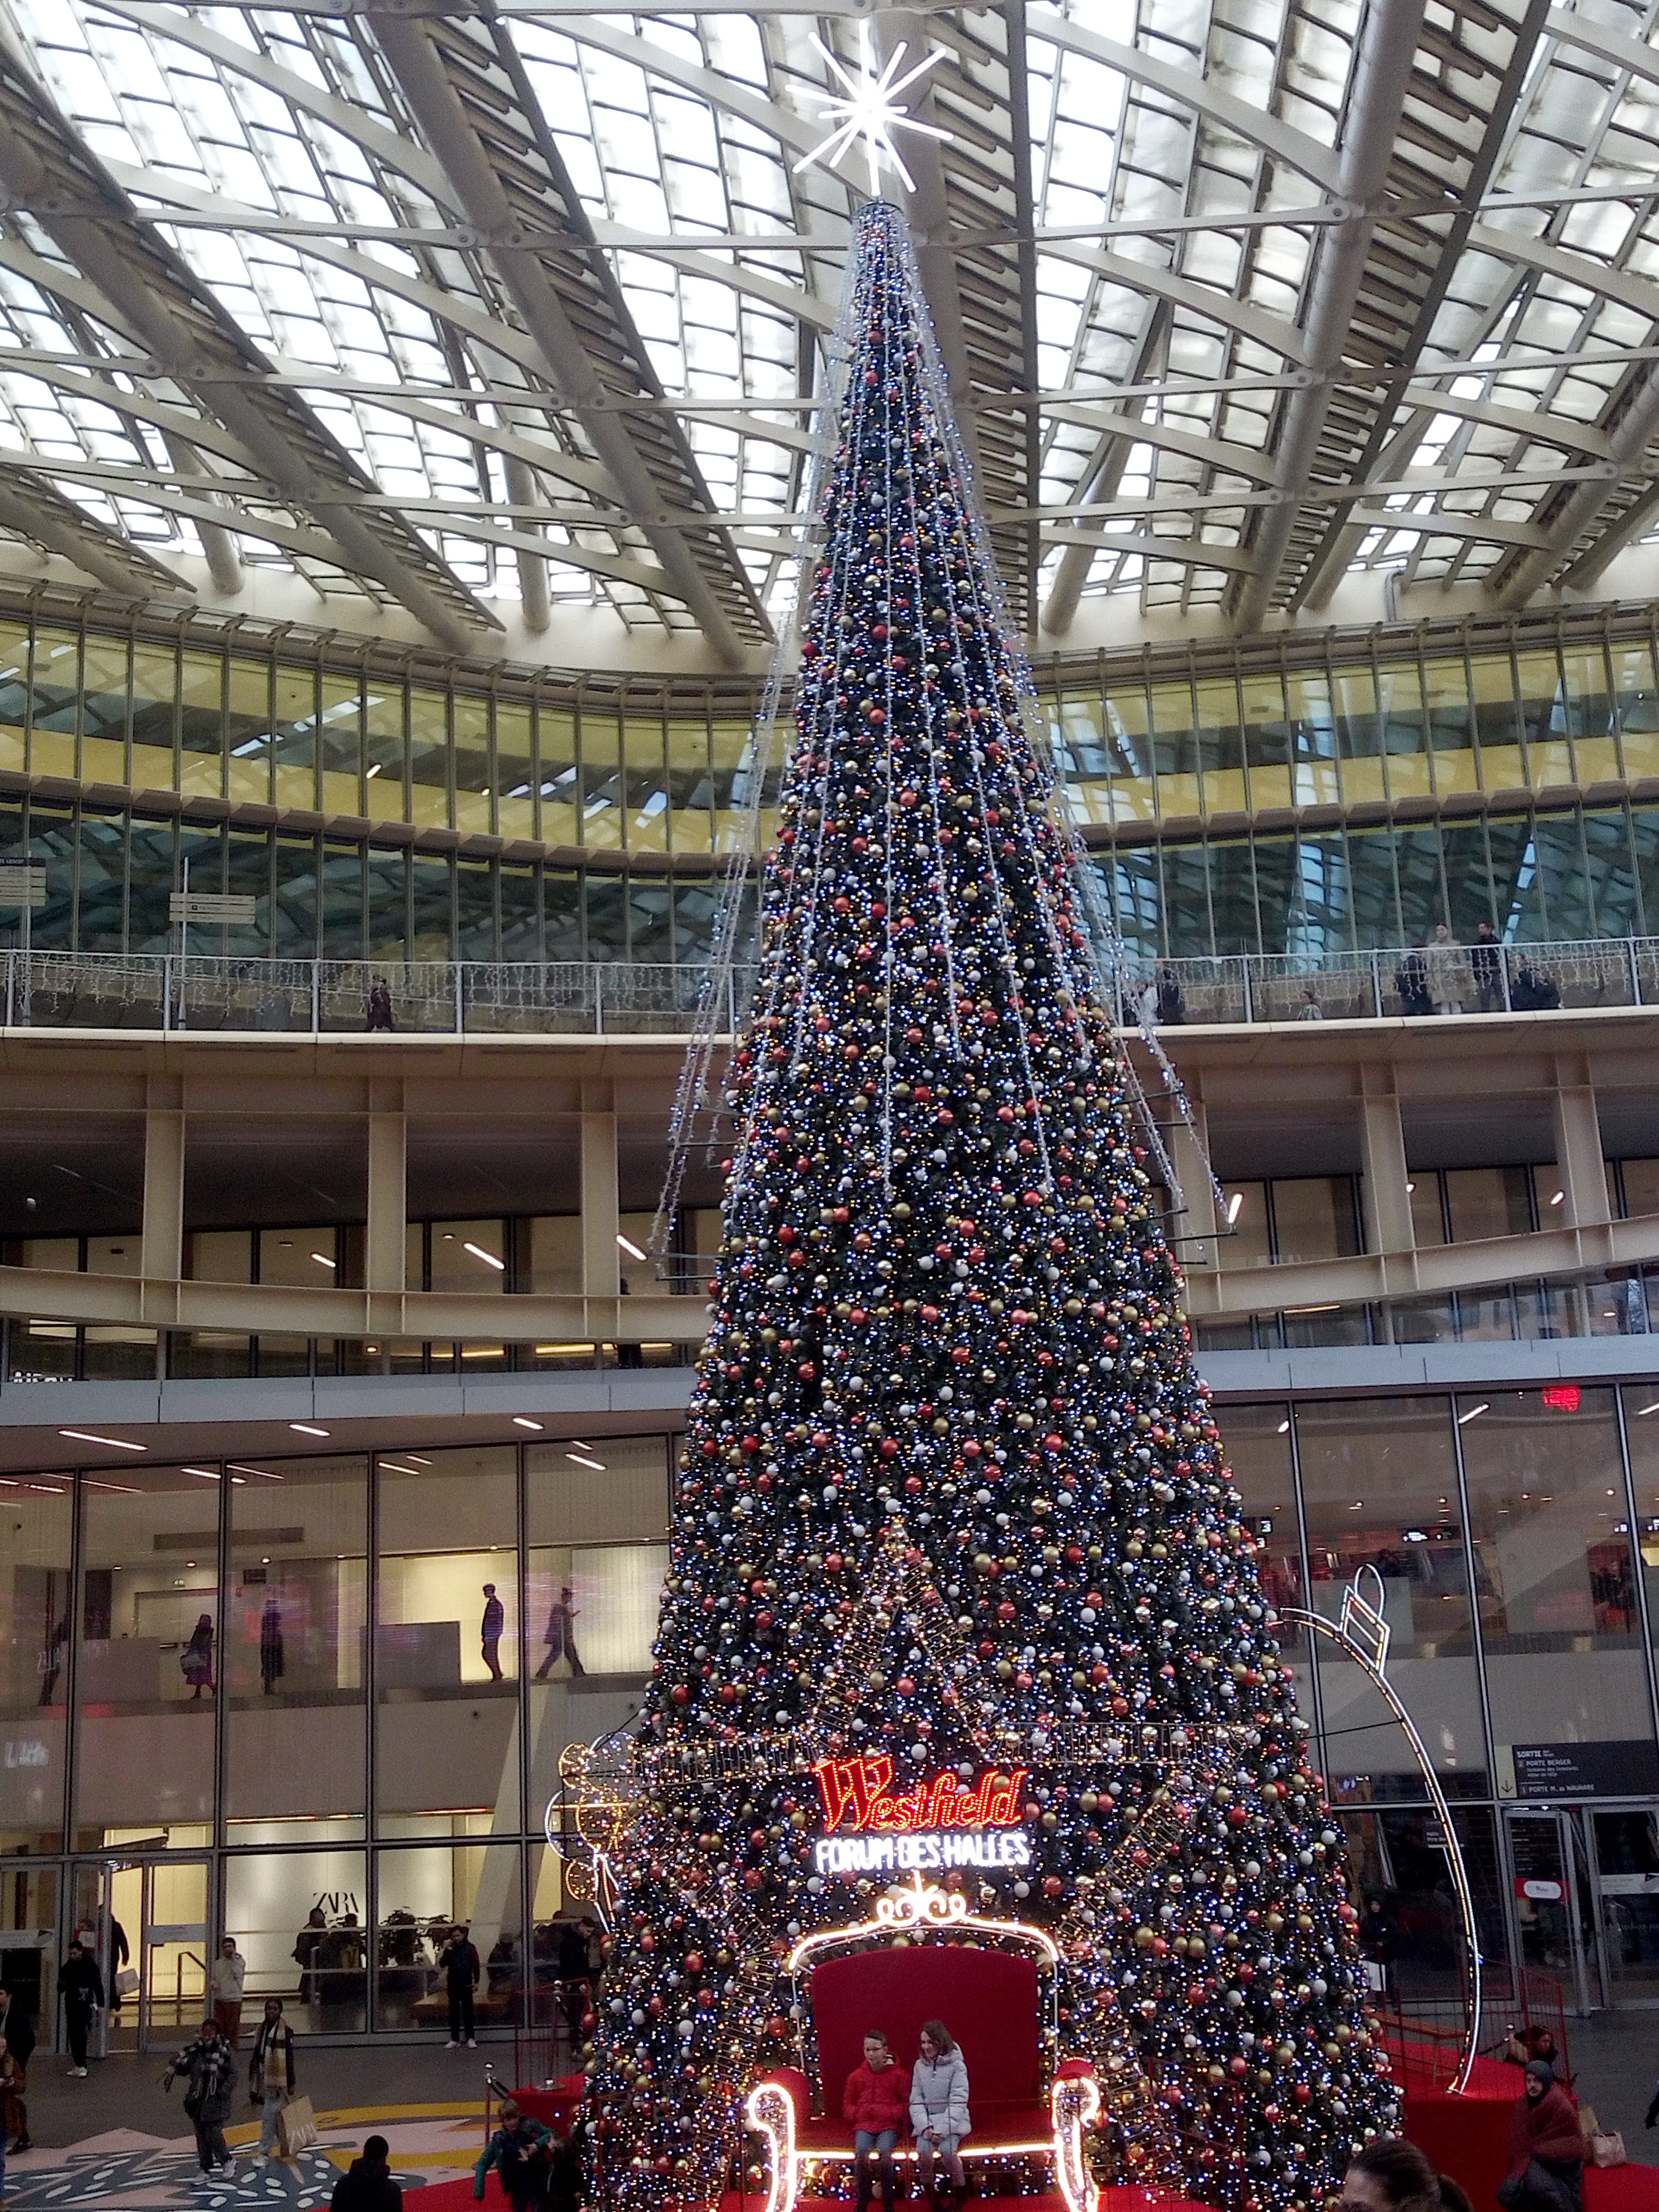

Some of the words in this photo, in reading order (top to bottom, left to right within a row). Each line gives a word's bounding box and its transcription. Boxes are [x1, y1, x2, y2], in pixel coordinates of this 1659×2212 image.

[812, 1754, 1029, 1834] Westfield
[815, 1837, 895, 1872] FORUM
[897, 1834, 941, 1869] DES
[943, 1832, 1030, 1867] HALLES
[313, 1892, 359, 1914] ZARA
